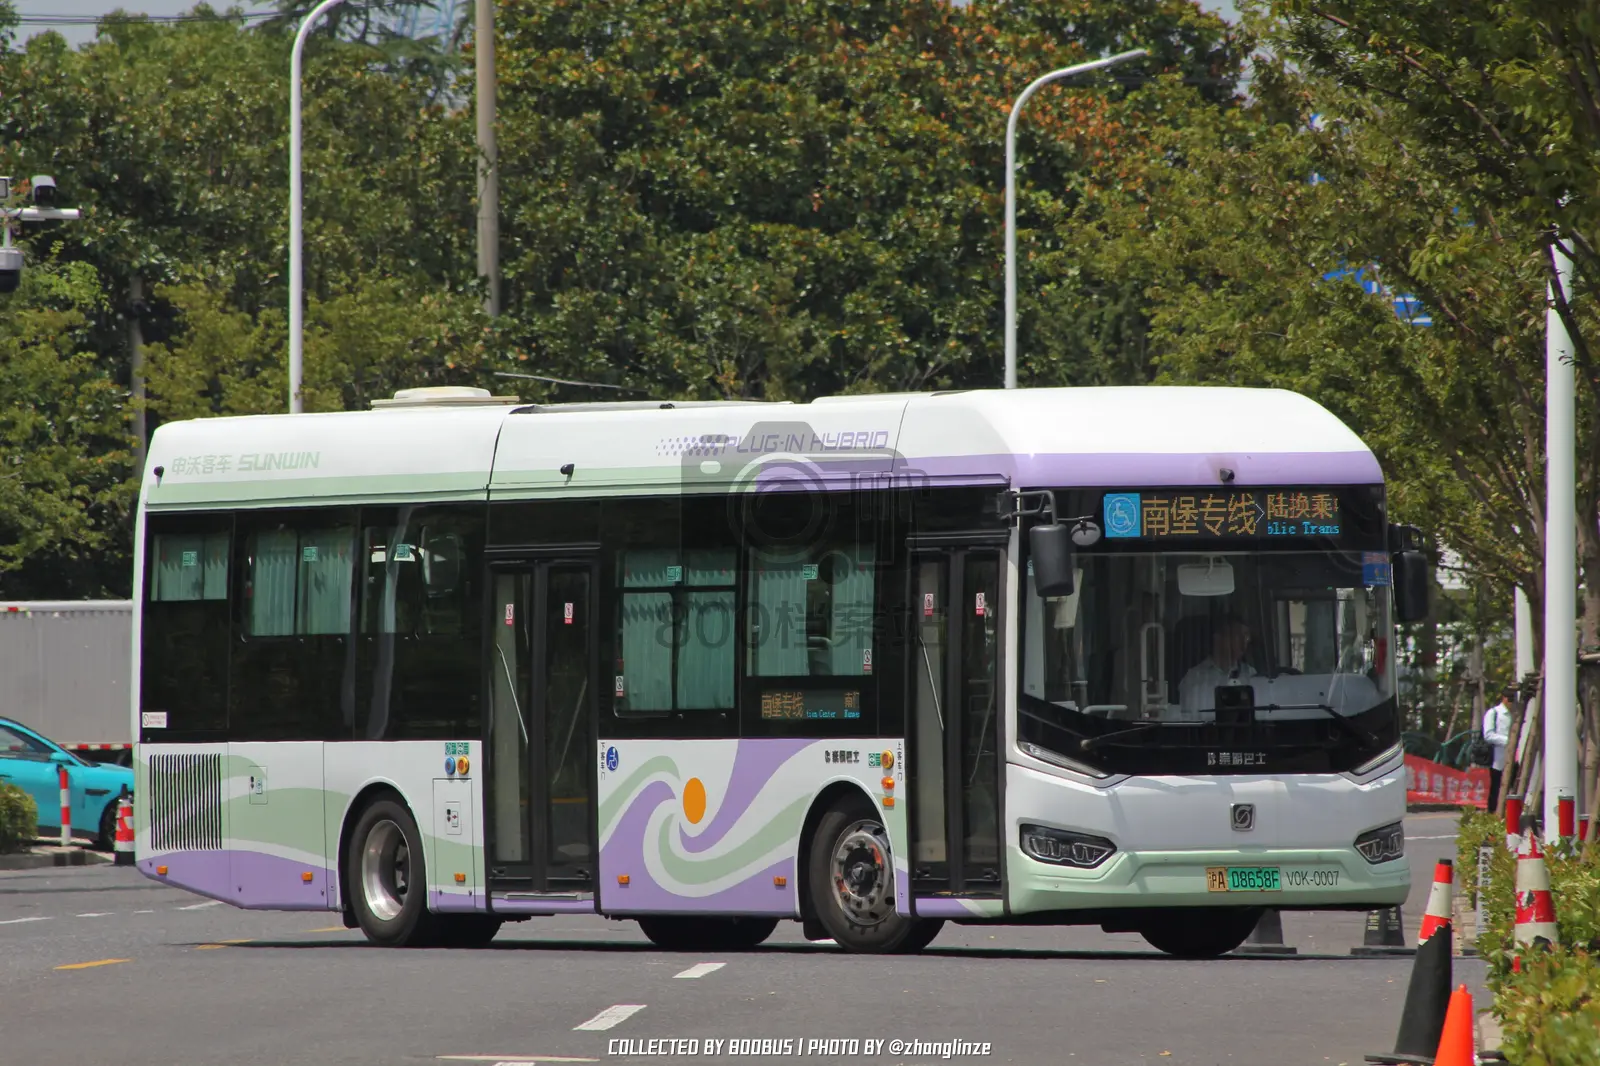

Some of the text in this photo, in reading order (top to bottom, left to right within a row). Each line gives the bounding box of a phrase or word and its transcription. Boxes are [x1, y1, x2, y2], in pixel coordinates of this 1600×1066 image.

[809, 430, 889, 452] HYBRID
[171, 455, 232, 475] 申沃客车
[237, 451, 320, 471] SUNWIN
[1142, 493, 1257, 536] 南堡专线
[1302, 521, 1340, 535] Trans
